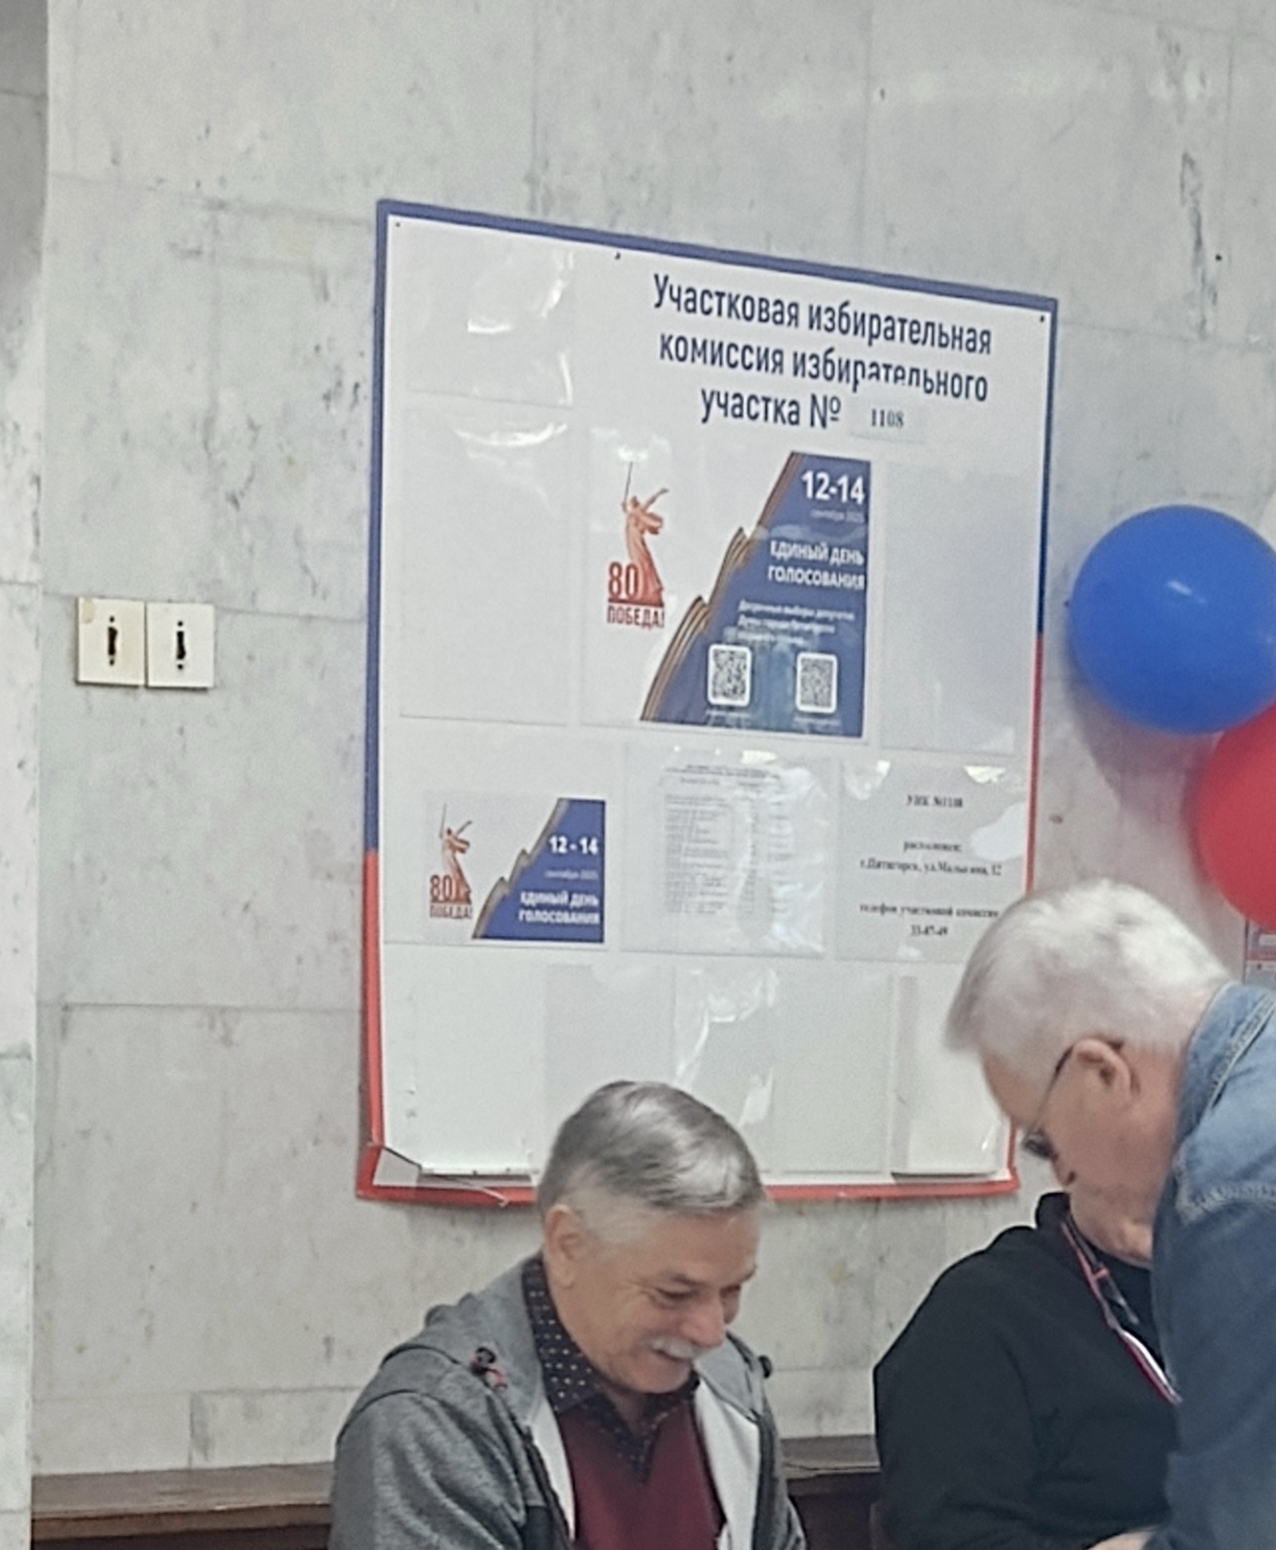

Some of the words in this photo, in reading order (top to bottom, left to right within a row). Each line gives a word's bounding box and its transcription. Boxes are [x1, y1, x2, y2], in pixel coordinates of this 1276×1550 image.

[653, 273, 799, 328] Участковая
[808, 301, 992, 355] избирательная
[659, 333, 785, 374] комиссия
[792, 347, 989, 402] избирательного
[701, 388, 800, 426] участка
[809, 394, 842, 428] №
[870, 408, 904, 429] 1108
[801, 470, 866, 504] 12-14
[770, 540, 828, 562] ЕДИНЫЙ
[829, 546, 865, 567] ДЕНЬ
[608, 561, 639, 598] 80
[768, 565, 866, 590] ГОЛОСОВАНИЯ
[607, 606, 665, 629] ПОБЕДА!
[430, 874, 453, 899] 80
